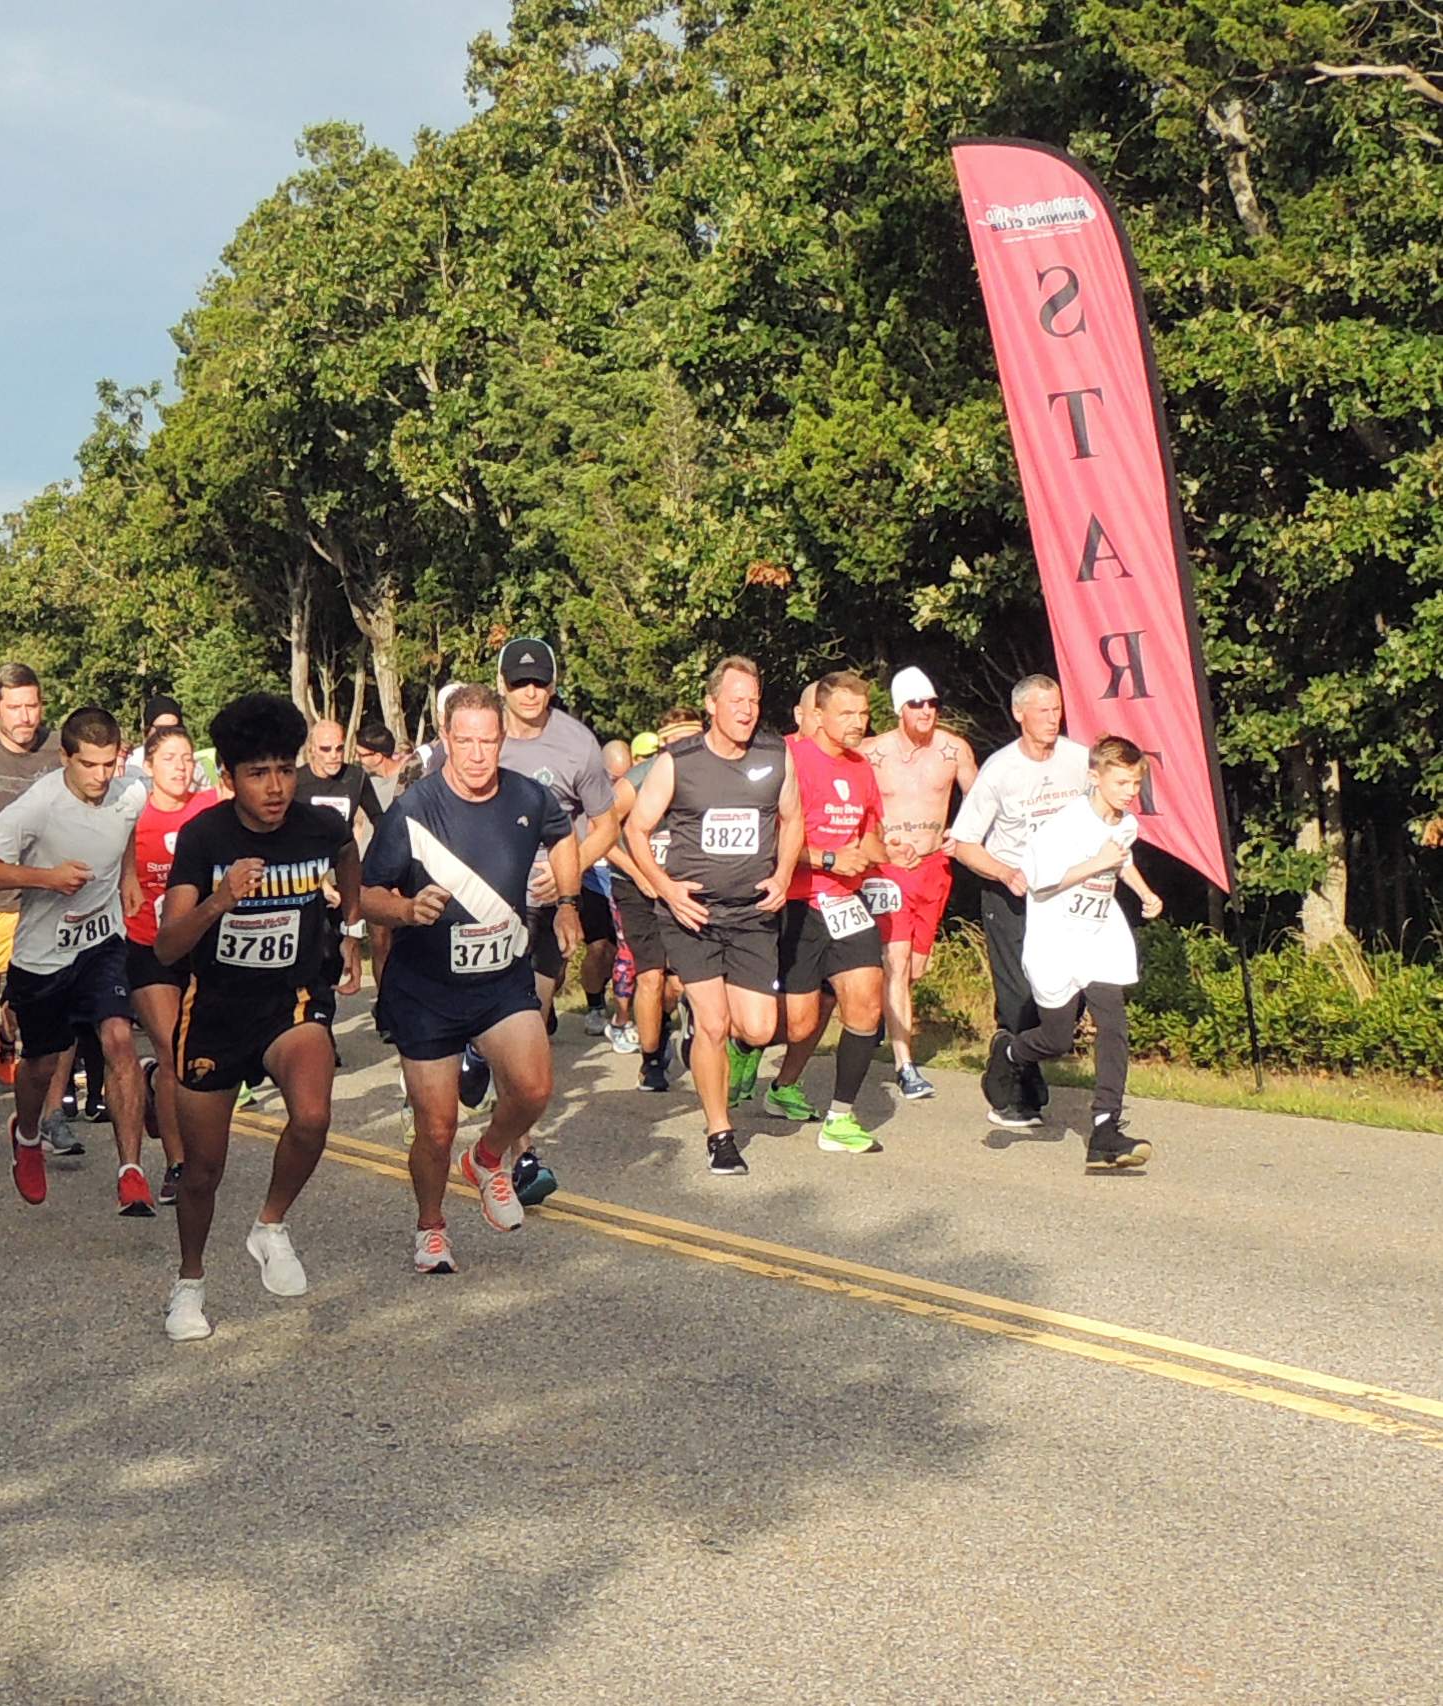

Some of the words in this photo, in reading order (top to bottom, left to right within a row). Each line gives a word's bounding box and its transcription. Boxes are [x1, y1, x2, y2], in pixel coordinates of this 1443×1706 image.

[705, 827, 756, 848] 3822
[147, 862, 172, 873] Ston
[869, 892, 899, 909] 784
[58, 915, 110, 947] 3780
[828, 905, 868, 933] 3756
[220, 933, 294, 961] 3786
[454, 934, 512, 966] 3717
